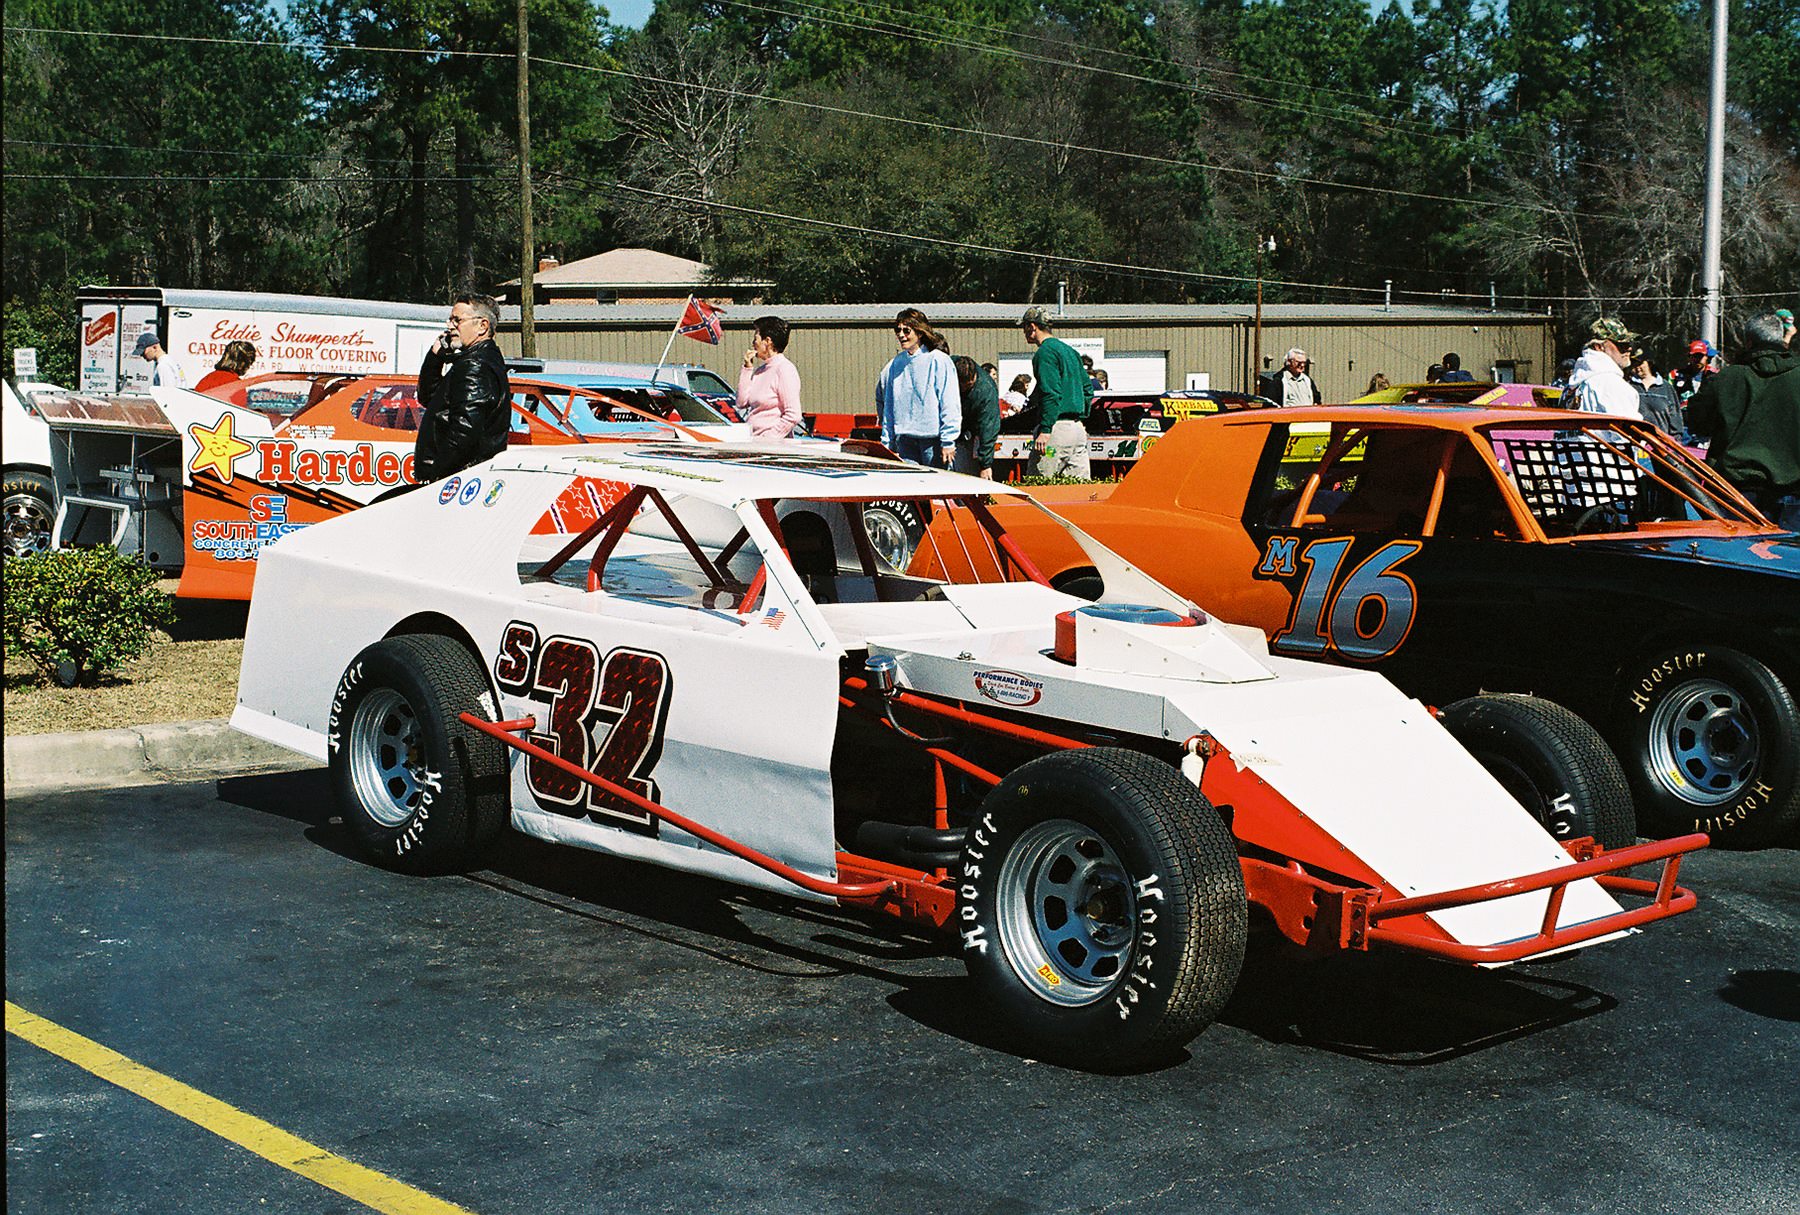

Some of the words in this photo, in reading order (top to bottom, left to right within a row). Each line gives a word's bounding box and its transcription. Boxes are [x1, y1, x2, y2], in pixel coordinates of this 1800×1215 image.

[188, 342, 228, 355] CARP
[269, 349, 314, 360] FLOOR
[321, 350, 387, 363] COVERING
[211, 319, 262, 341] Eddie
[271, 321, 374, 350] Shumpert's
[1163, 400, 1217, 415] KIMBALL
[3, 477, 41, 492] osier
[1273, 536, 1423, 663] 16
[973, 671, 1019, 685] PERFORMANCE
[1019, 679, 1044, 689] BODIES
[1630, 652, 1706, 713] Hoosier
[329, 661, 363, 754] Hoosier
[525, 635, 672, 838] 32
[960, 812, 997, 953] Hoosier
[1115, 874, 1165, 1020] Hoosier
[1040, 967, 1059, 984] AERO
